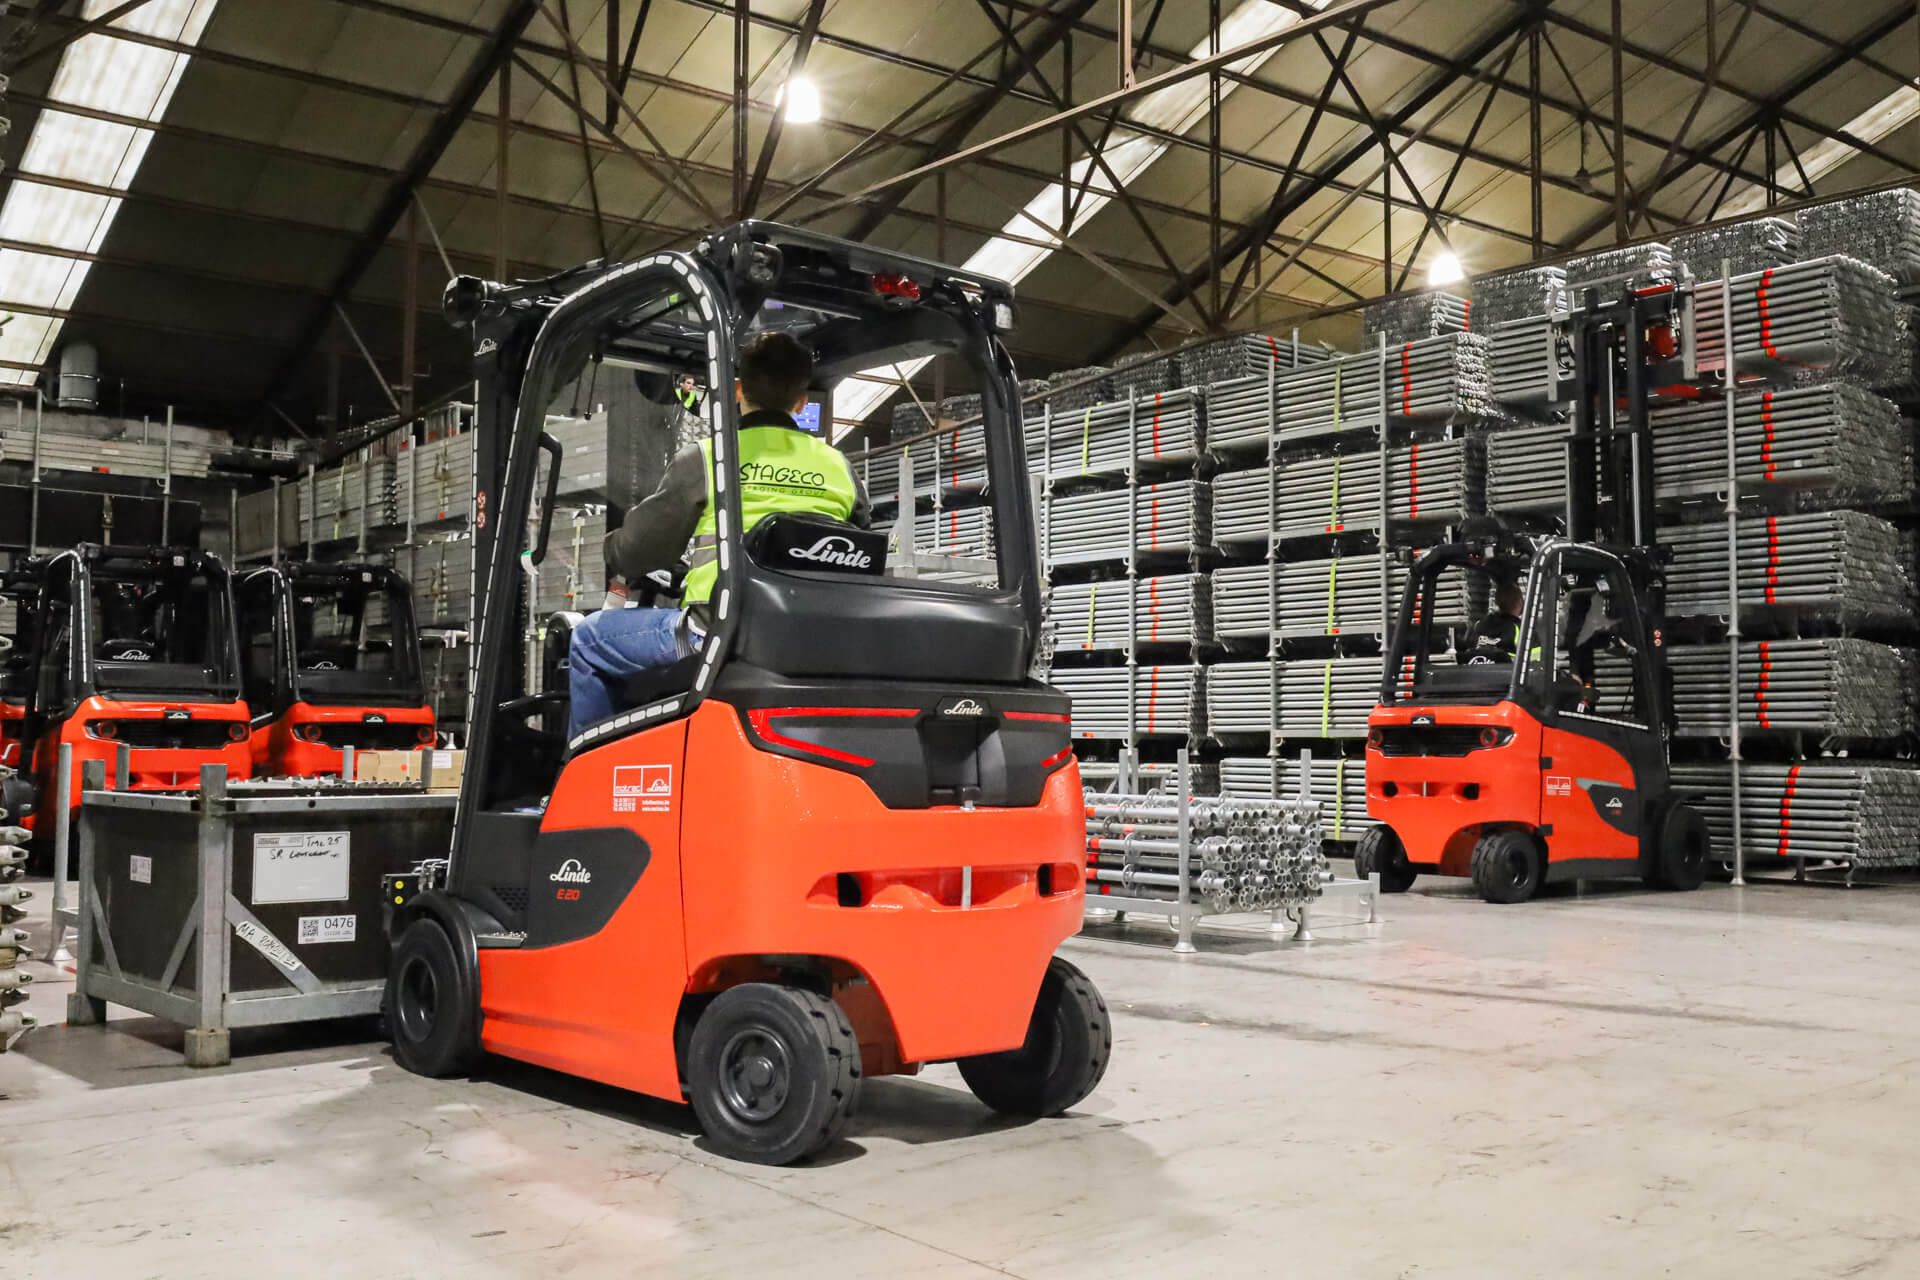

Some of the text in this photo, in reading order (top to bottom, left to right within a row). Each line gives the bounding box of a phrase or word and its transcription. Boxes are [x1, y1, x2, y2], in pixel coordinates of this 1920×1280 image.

[740, 462, 825, 486] STAGECO
[788, 535, 872, 569] Linde
[112, 649, 151, 661] Linde
[943, 699, 984, 716] Linde
[549, 858, 592, 884] Linde
[324, 917, 354, 929] 0476
